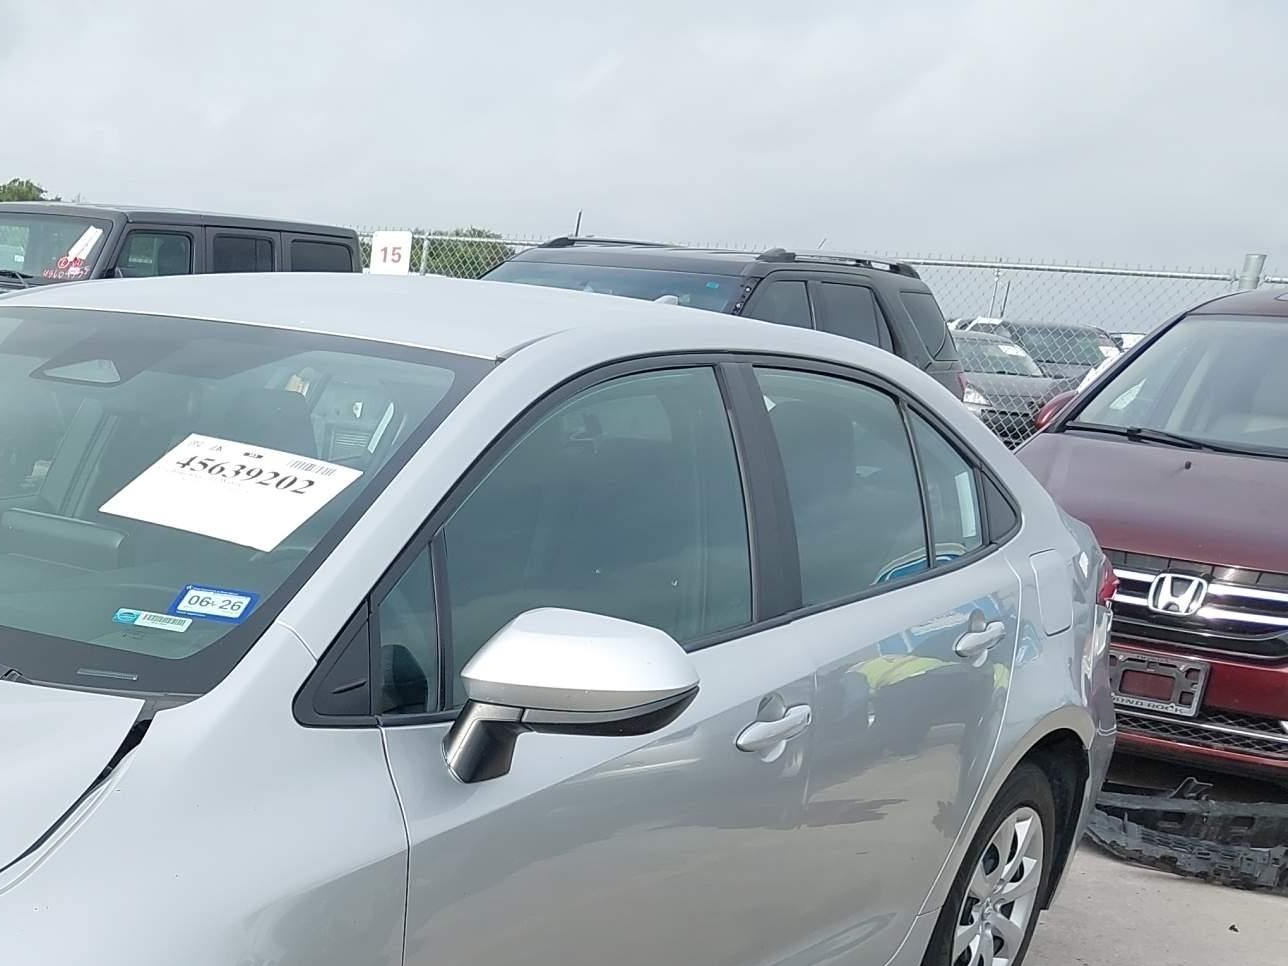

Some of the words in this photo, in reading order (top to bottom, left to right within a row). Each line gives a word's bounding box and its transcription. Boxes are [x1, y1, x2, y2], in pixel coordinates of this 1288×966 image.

[380, 246, 402, 263] 15
[176, 455, 315, 495] 45639202
[187, 594, 212, 607] 06
[219, 599, 244, 612] 26
